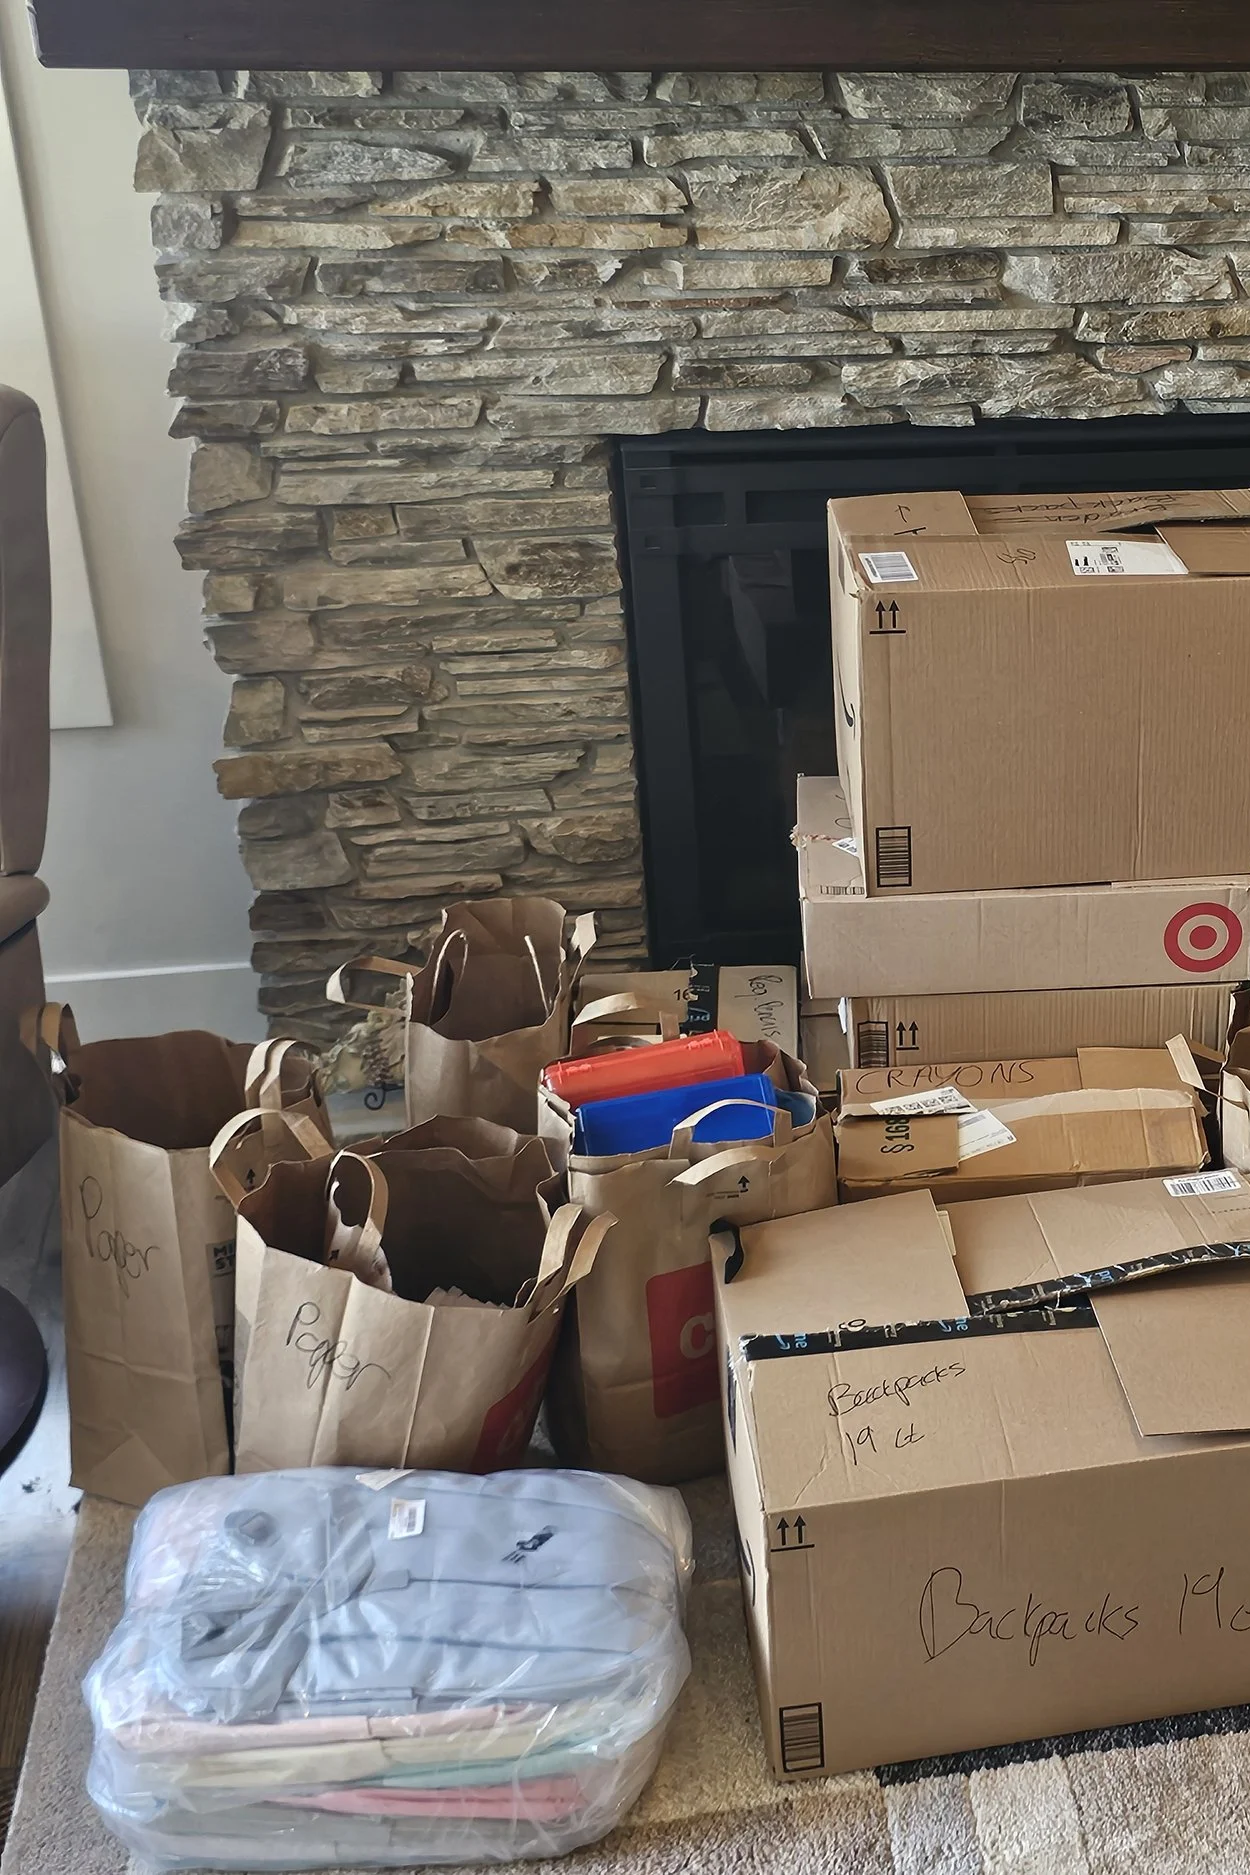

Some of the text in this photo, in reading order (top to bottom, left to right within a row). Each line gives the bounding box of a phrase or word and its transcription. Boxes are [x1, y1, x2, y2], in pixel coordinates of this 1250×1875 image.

[855, 1059, 1042, 1094] CRAYONS
[79, 1176, 161, 1299] Paper
[286, 1301, 392, 1391] Paper
[827, 1362, 967, 1416] Backpacks
[845, 1426, 877, 1466] 19
[919, 1566, 1140, 1667] Backpacks
[1178, 1566, 1225, 1635] 19
